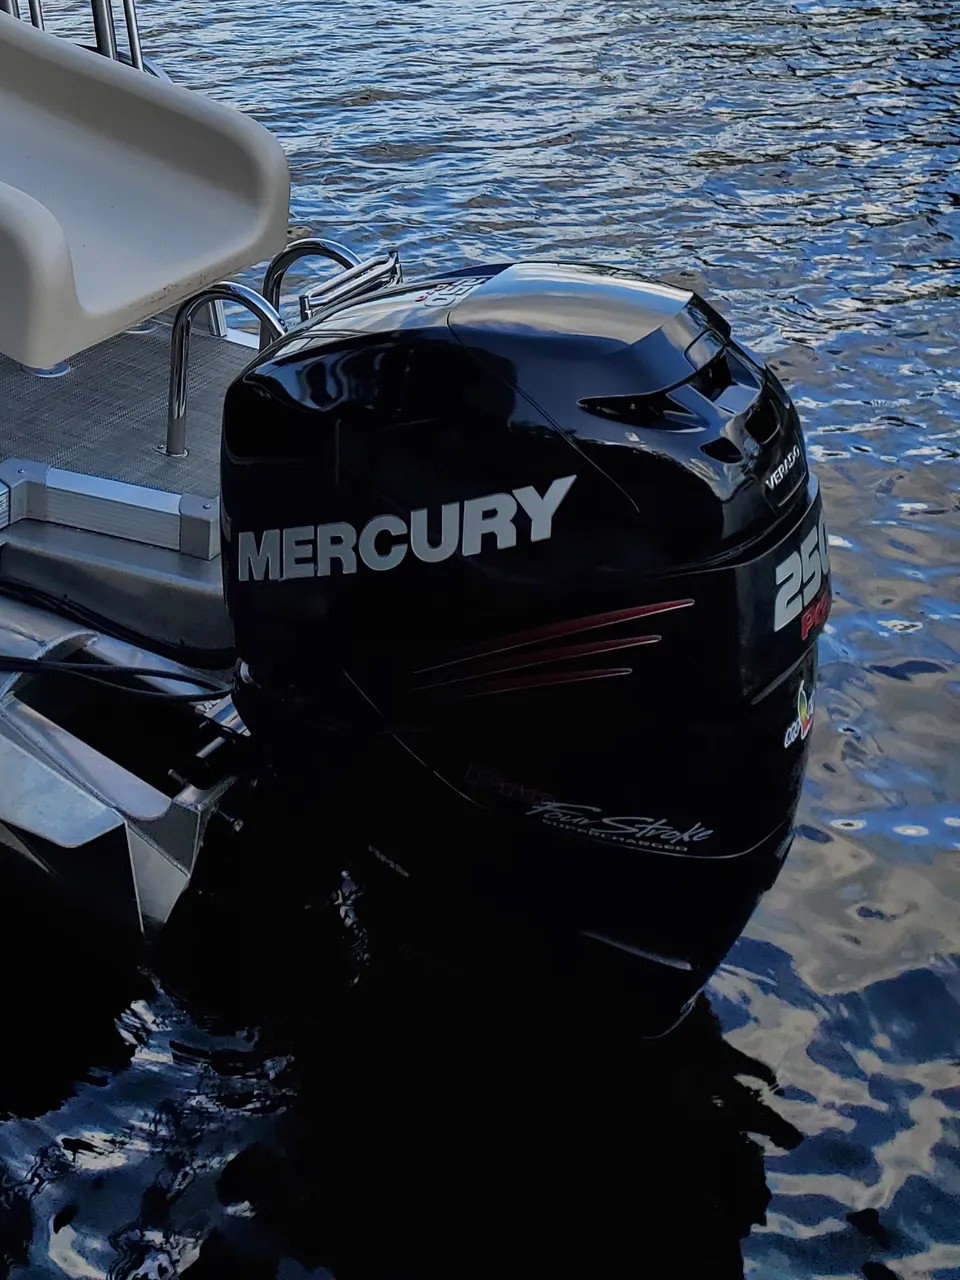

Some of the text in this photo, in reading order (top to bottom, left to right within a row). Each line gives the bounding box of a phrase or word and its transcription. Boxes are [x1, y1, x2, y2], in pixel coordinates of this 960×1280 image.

[765, 445, 800, 491] VERADO
[239, 475, 577, 582] MERCURY
[773, 509, 829, 633] 250
